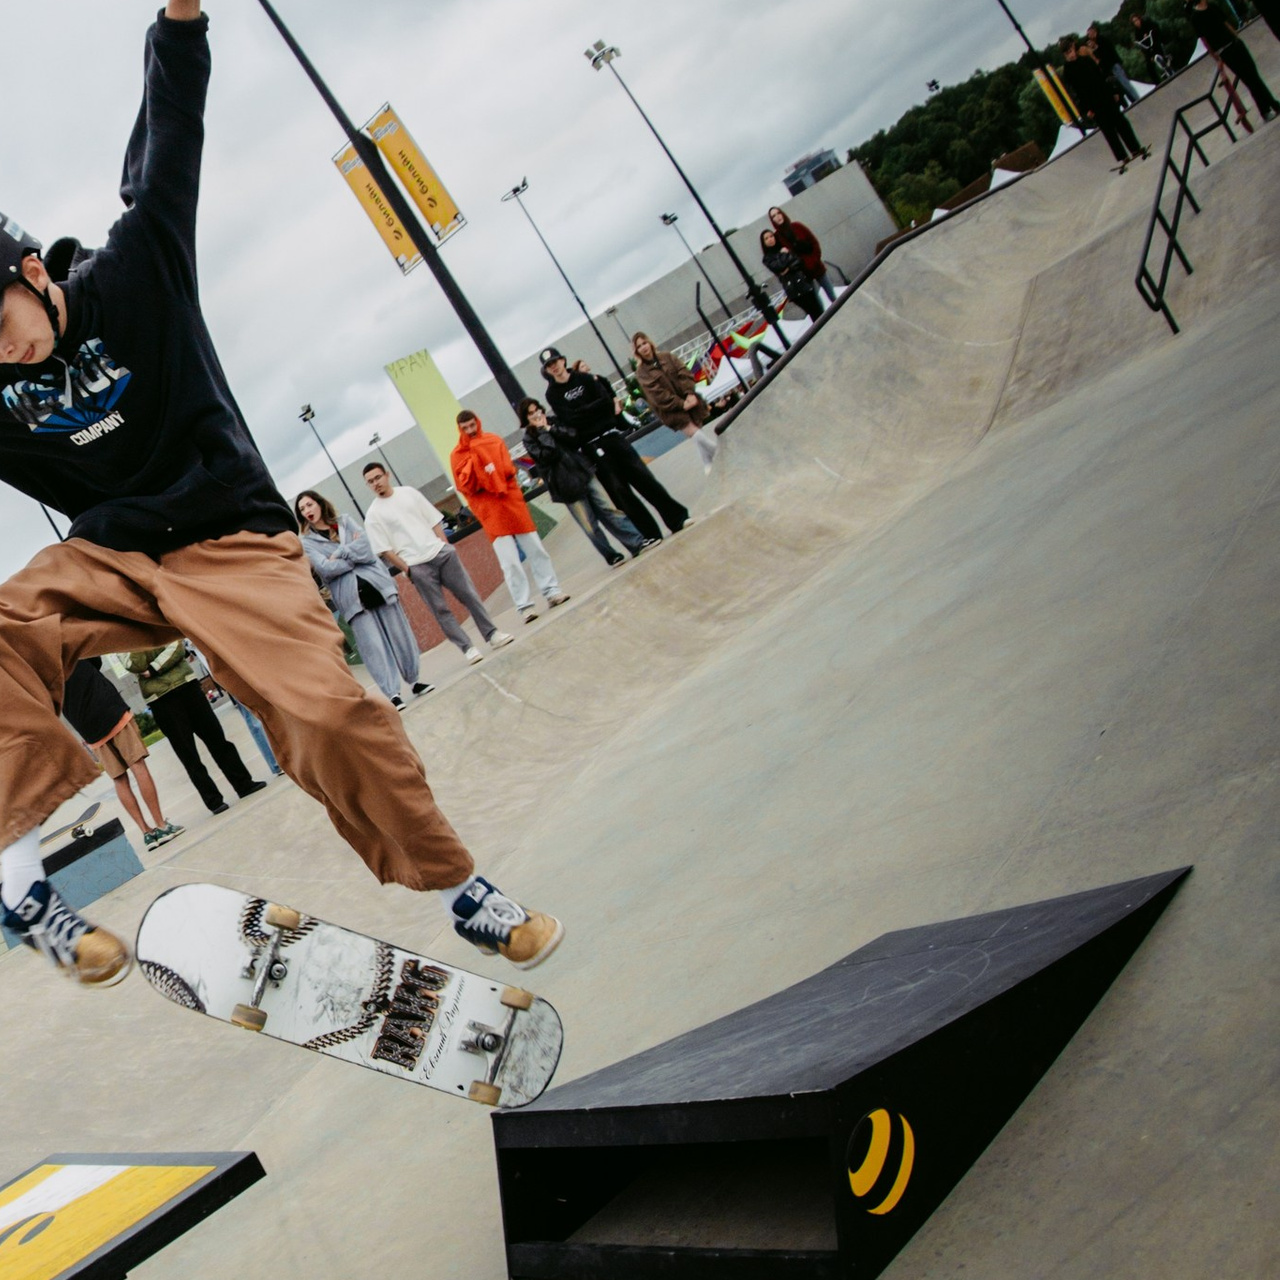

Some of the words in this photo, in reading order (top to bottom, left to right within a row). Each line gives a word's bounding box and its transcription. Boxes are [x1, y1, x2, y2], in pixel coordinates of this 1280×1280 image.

[398, 149, 429, 195] билайн
[366, 183, 395, 227] билайн
[70, 410, 125, 446] COMPANY
